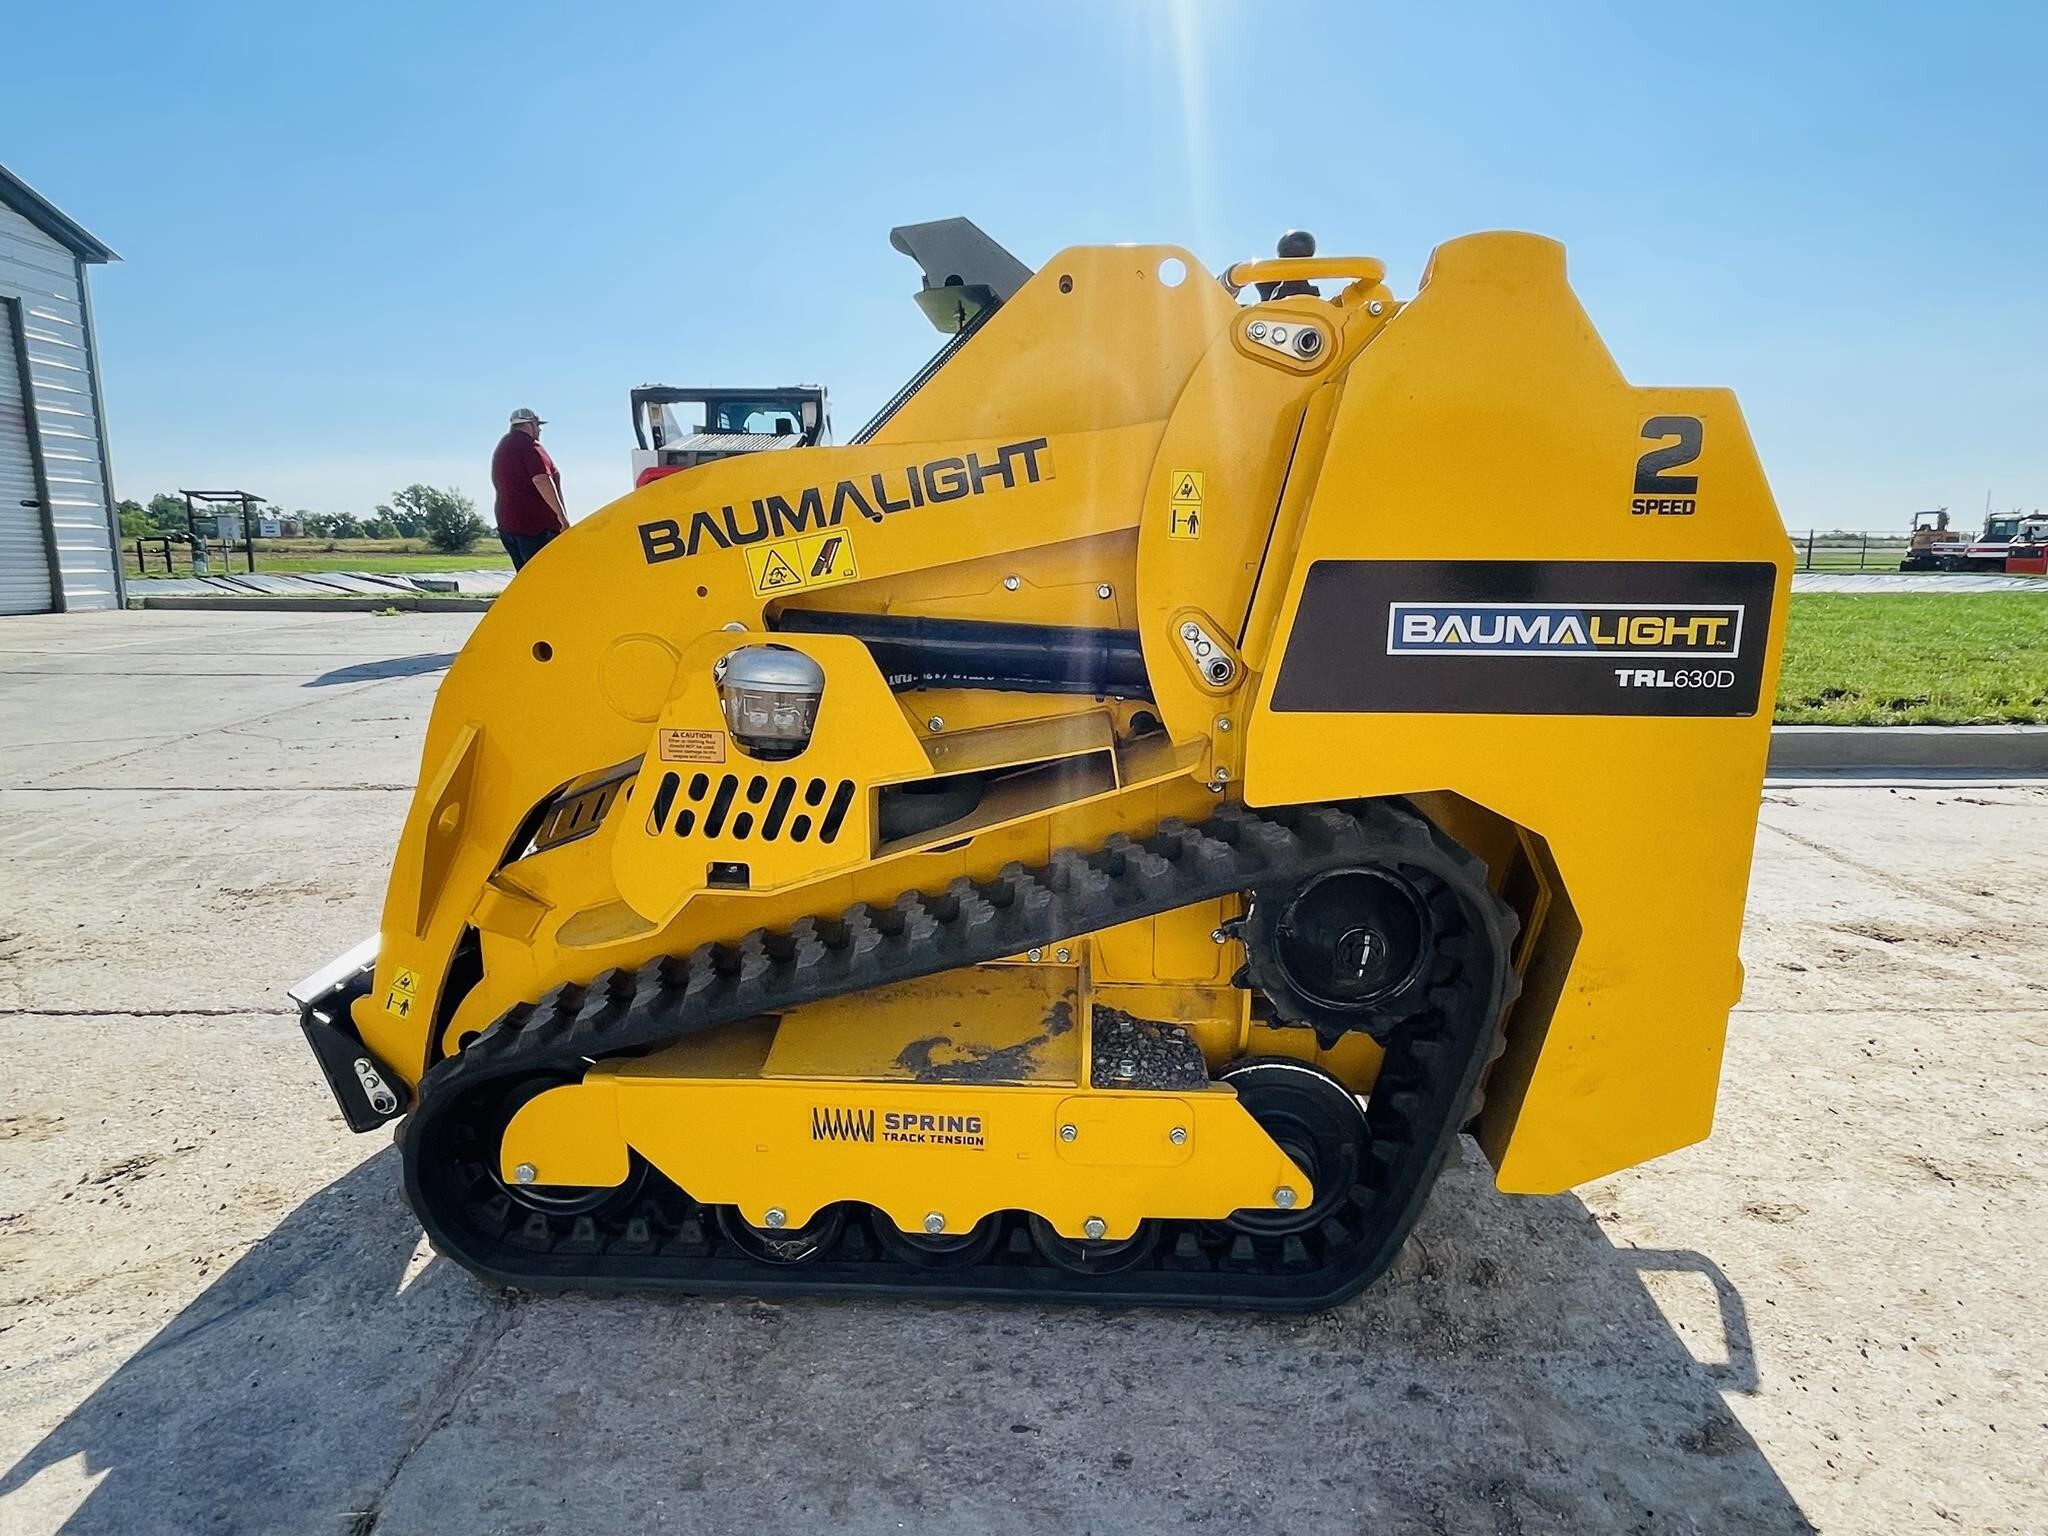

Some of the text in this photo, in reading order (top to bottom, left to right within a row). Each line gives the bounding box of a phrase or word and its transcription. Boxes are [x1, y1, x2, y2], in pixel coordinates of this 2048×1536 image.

[1633, 416, 1703, 494] 2
[637, 437, 1048, 565] BAUMALIGHT
[1631, 499, 1696, 515] SPEED
[1402, 614, 1729, 646] BAUMALIGHT
[1614, 668, 1735, 688] TRL630D
[885, 1112, 981, 1133] SPRING
[883, 1132, 984, 1146] TRACK TENSION
